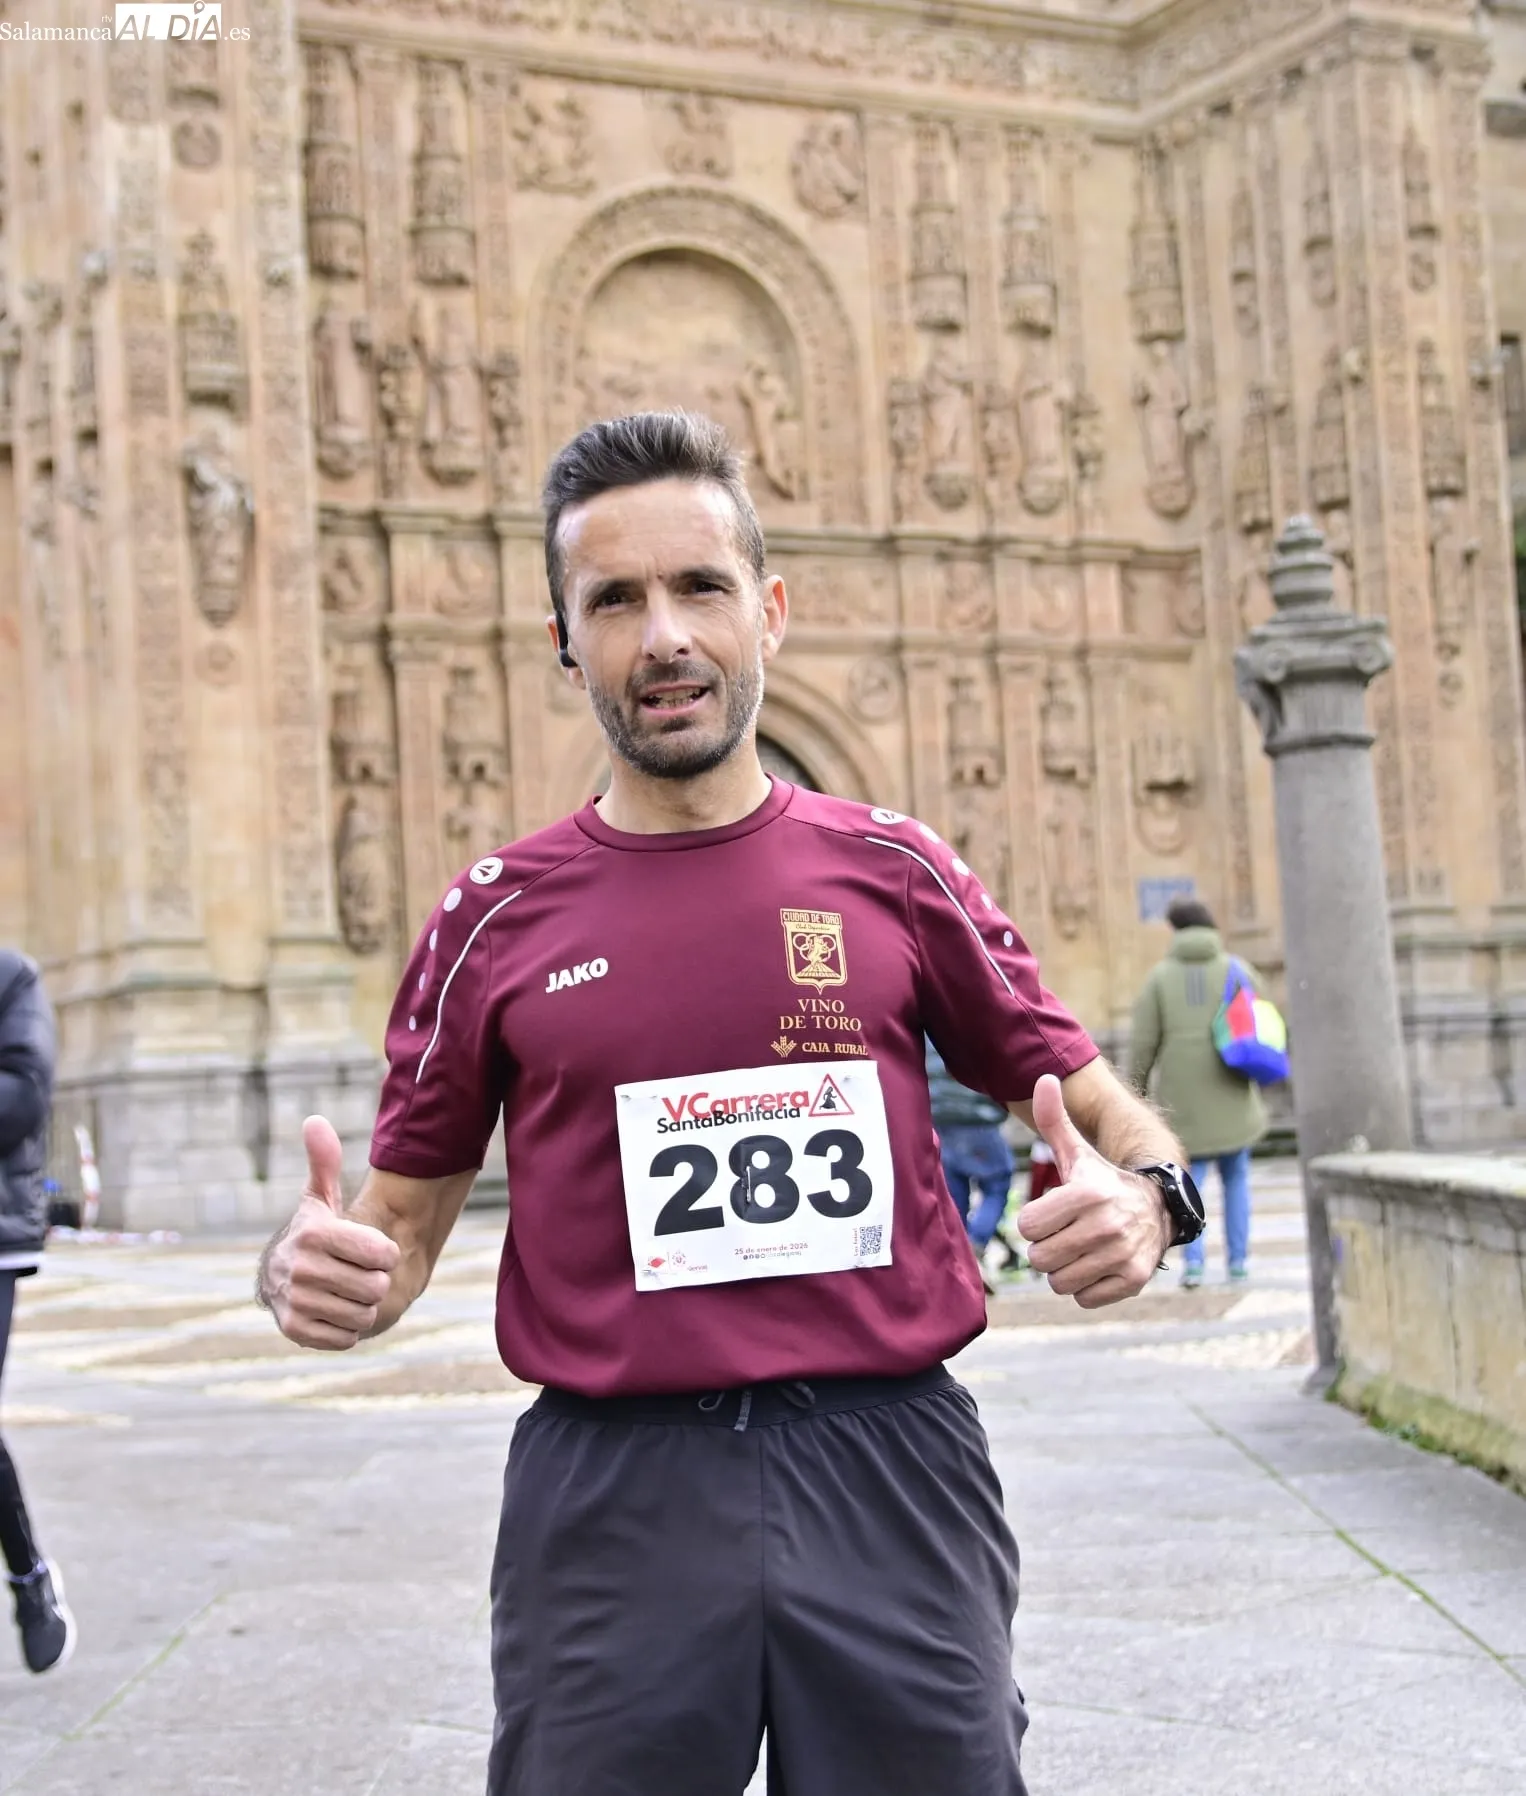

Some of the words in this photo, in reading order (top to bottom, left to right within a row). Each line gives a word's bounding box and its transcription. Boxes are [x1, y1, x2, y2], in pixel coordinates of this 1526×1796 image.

[783, 911, 810, 922] CIUDAD
[811, 913, 821, 923] DE
[822, 914, 840, 925] TORO
[545, 957, 609, 994] JAKO
[798, 999, 845, 1014] VINO
[780, 1016, 807, 1030] DE
[811, 1015, 862, 1032] TORO
[802, 1042, 831, 1053] CAJA
[834, 1043, 868, 1056] RURAL
[649, 1129, 873, 1237] 283
